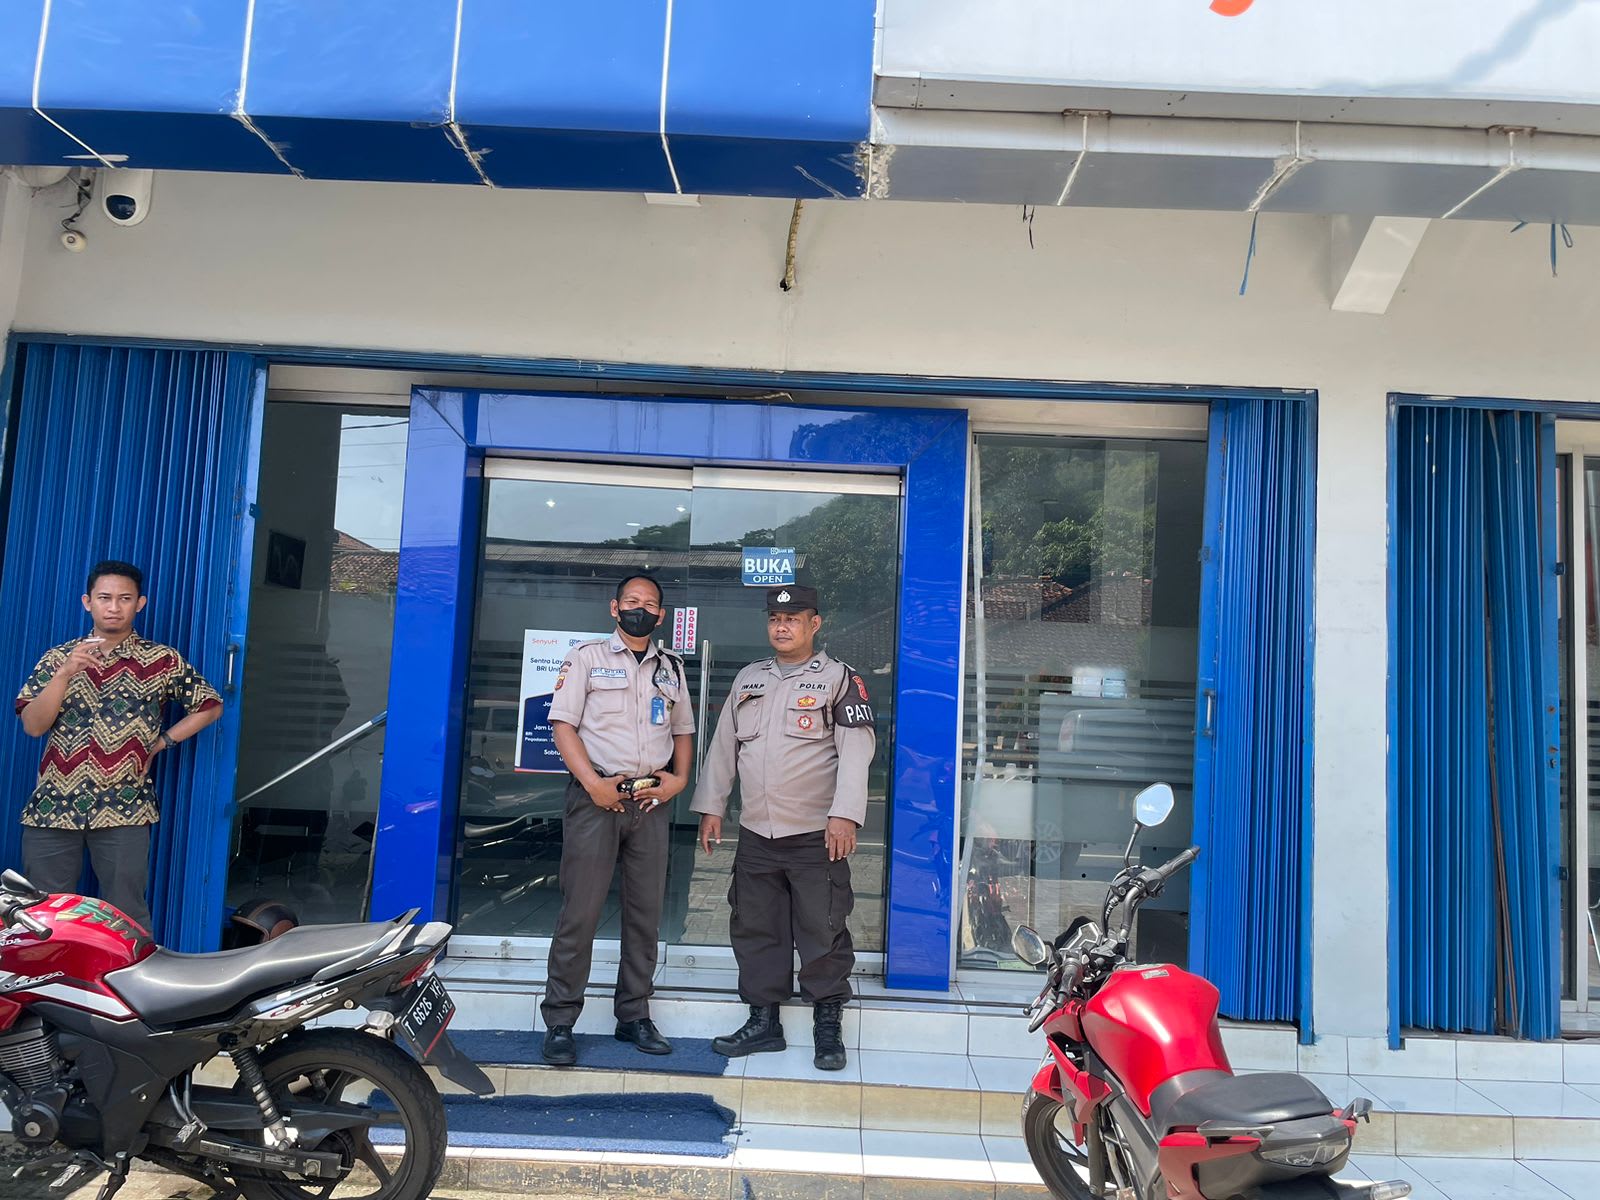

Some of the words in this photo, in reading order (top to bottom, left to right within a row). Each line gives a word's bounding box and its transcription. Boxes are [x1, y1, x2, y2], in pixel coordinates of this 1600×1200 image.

[744, 558, 792, 574] BUKA
[753, 575, 783, 584] OPEN
[687, 609, 695, 649] DORONG
[552, 658, 564, 666] Lay
[799, 682, 826, 690] POLRI
[404, 1020, 415, 1037] T
[412, 997, 432, 1026] 6626
[430, 981, 442, 998] XF
